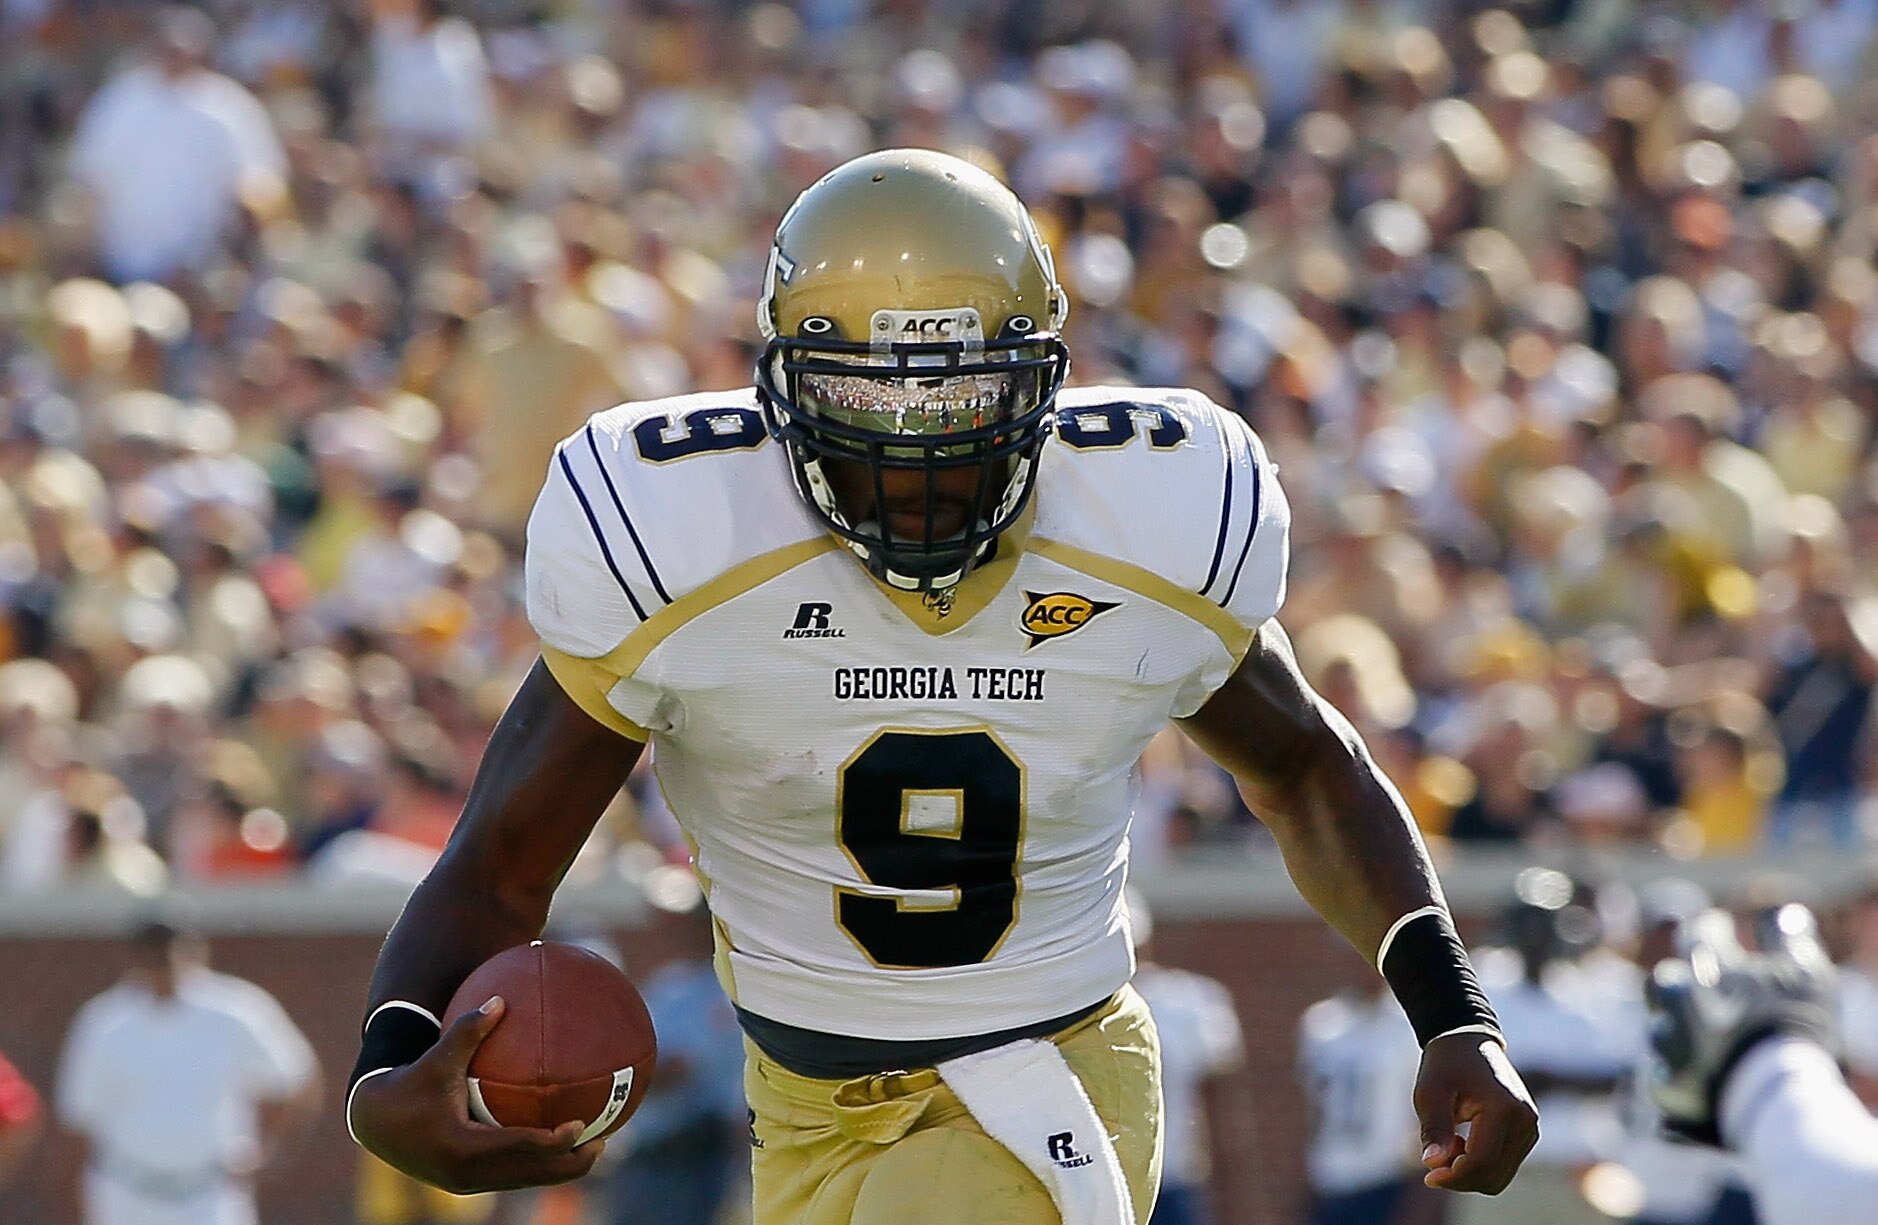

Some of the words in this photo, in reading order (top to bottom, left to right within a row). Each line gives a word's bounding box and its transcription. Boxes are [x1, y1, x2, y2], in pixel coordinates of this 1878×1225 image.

[901, 317, 955, 336] ACC
[633, 407, 771, 466] 9
[1055, 401, 1189, 452] 9
[1027, 604, 1085, 625] ACC
[783, 628, 847, 639] RUSSELL
[834, 667, 958, 700] GEORGIA
[967, 668, 1046, 701] TECH
[833, 724, 1029, 970] 9
